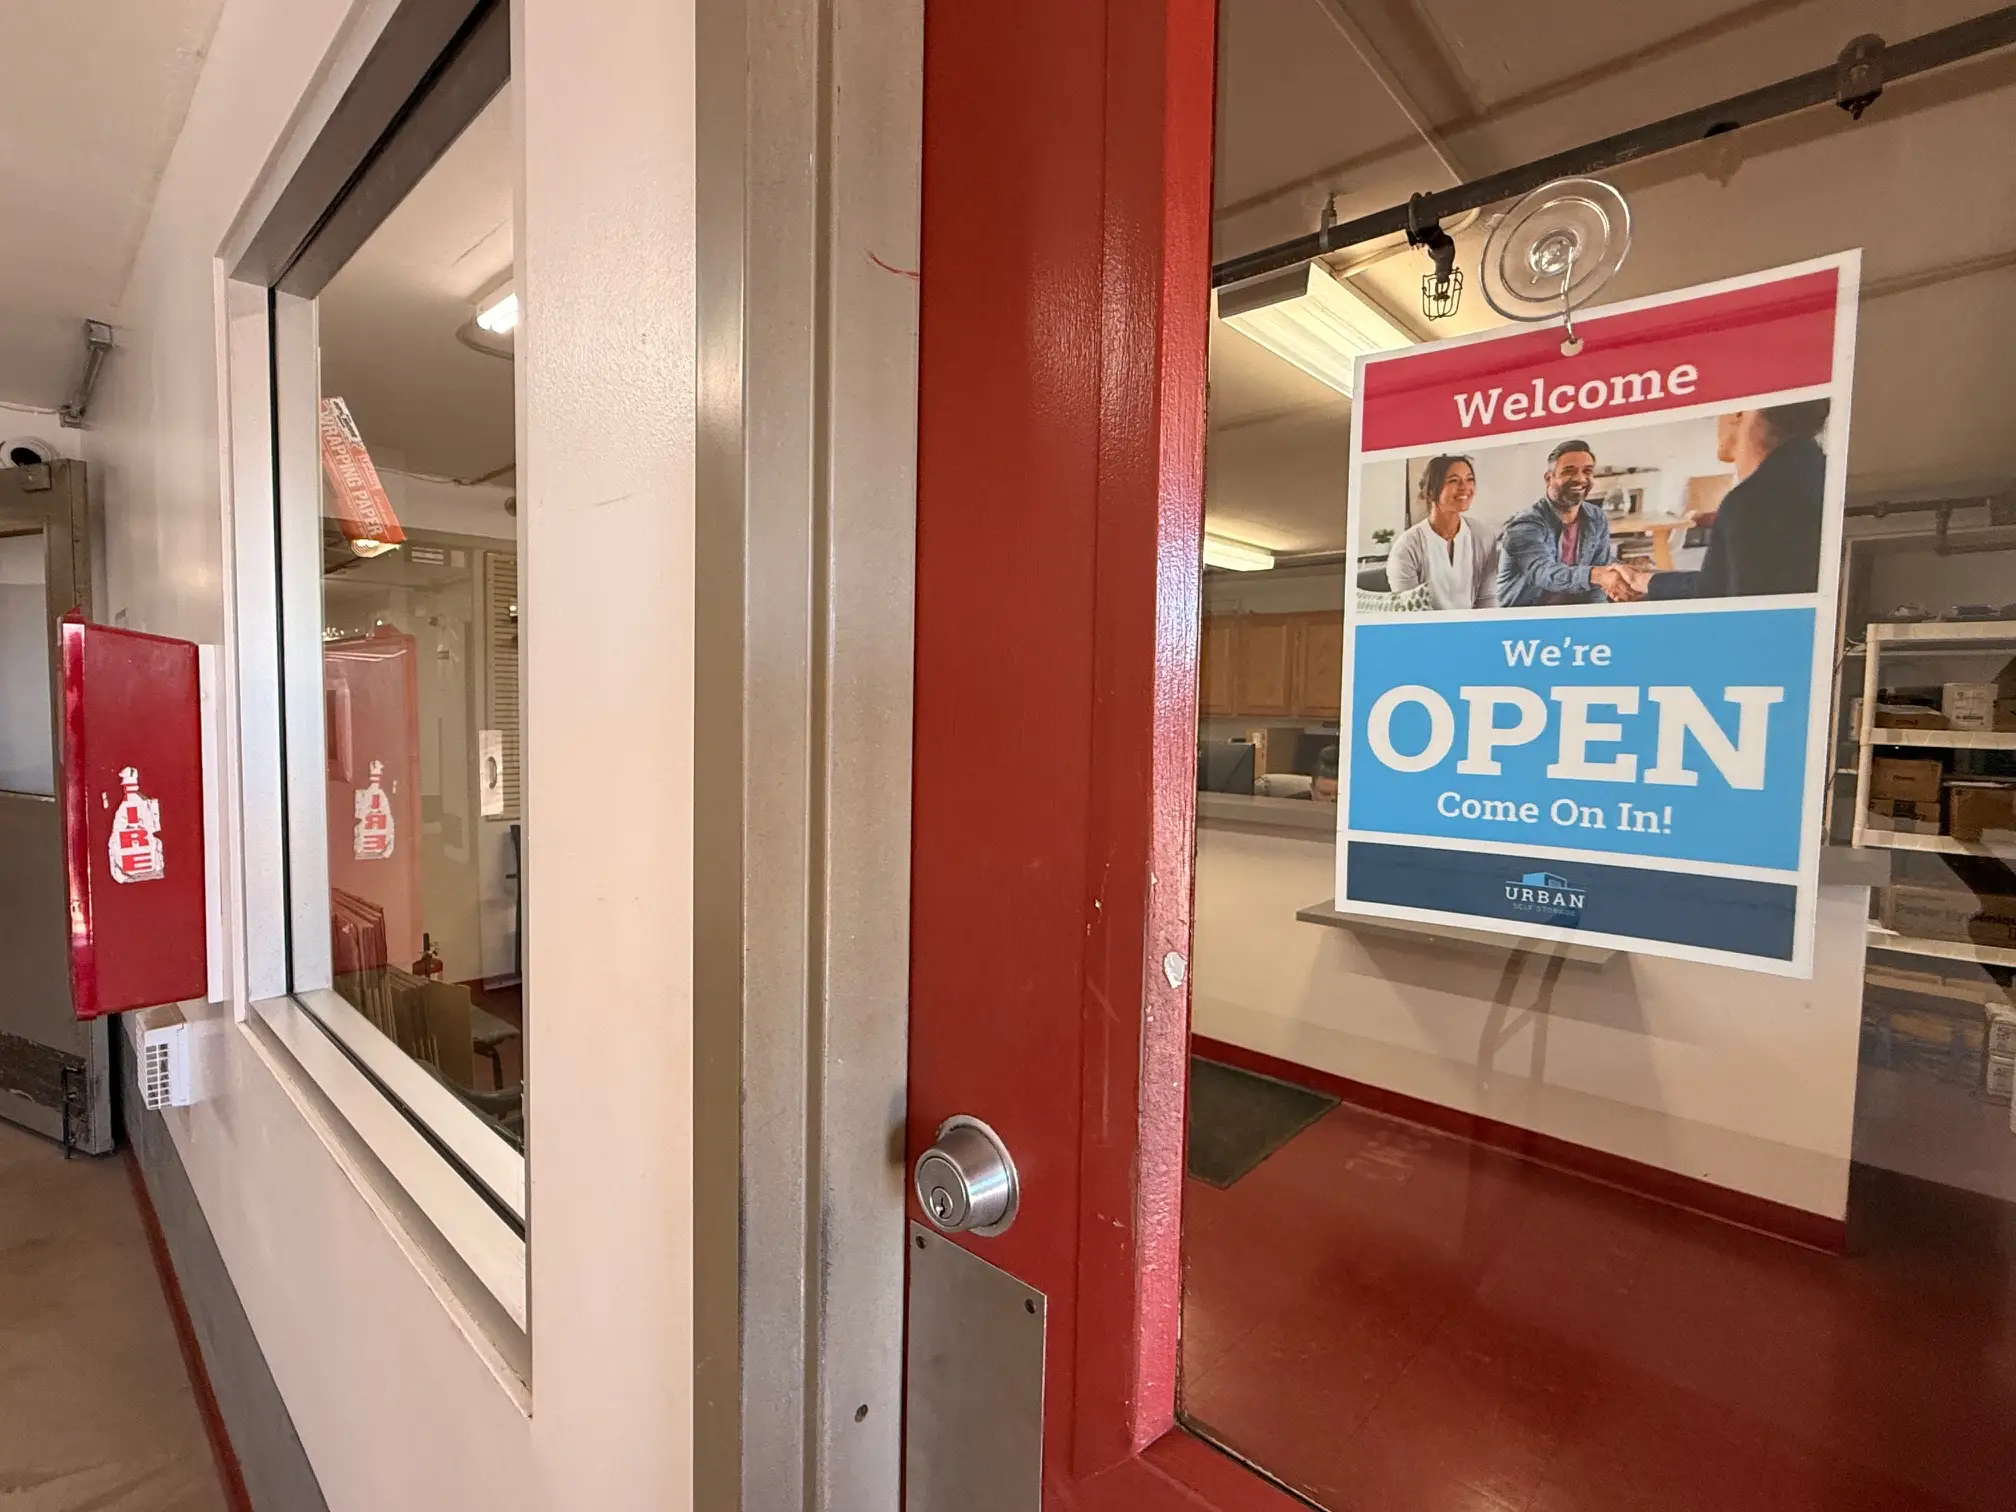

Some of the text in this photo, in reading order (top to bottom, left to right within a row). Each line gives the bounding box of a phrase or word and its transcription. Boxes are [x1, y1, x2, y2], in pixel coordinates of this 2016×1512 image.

[1453, 364, 1699, 428] Welcome
[352, 488, 384, 537] PAPER
[1502, 637, 1612, 667] We're
[1367, 684, 1784, 790] OPEN
[1437, 791, 1673, 835] Come On In!
[1504, 886, 1585, 908] URBAN
